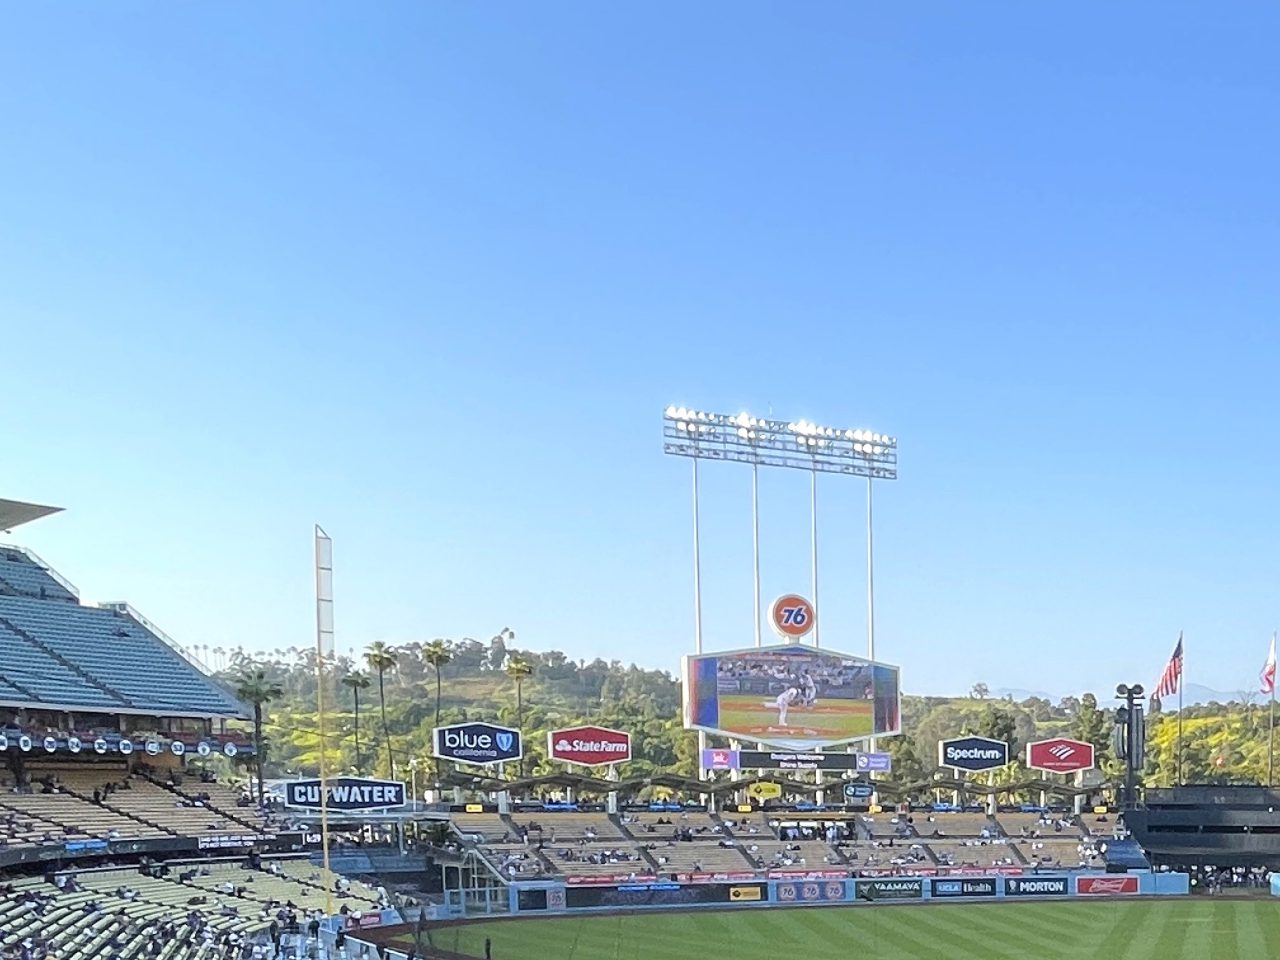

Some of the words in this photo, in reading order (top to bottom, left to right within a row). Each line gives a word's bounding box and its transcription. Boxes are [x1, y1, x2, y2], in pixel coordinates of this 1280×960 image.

[782, 606, 806, 625] 76
[445, 730, 492, 748] blue
[947, 747, 1000, 760] Spectrum
[963, 881, 992, 893] Health
[1019, 881, 1064, 892] MORTON
